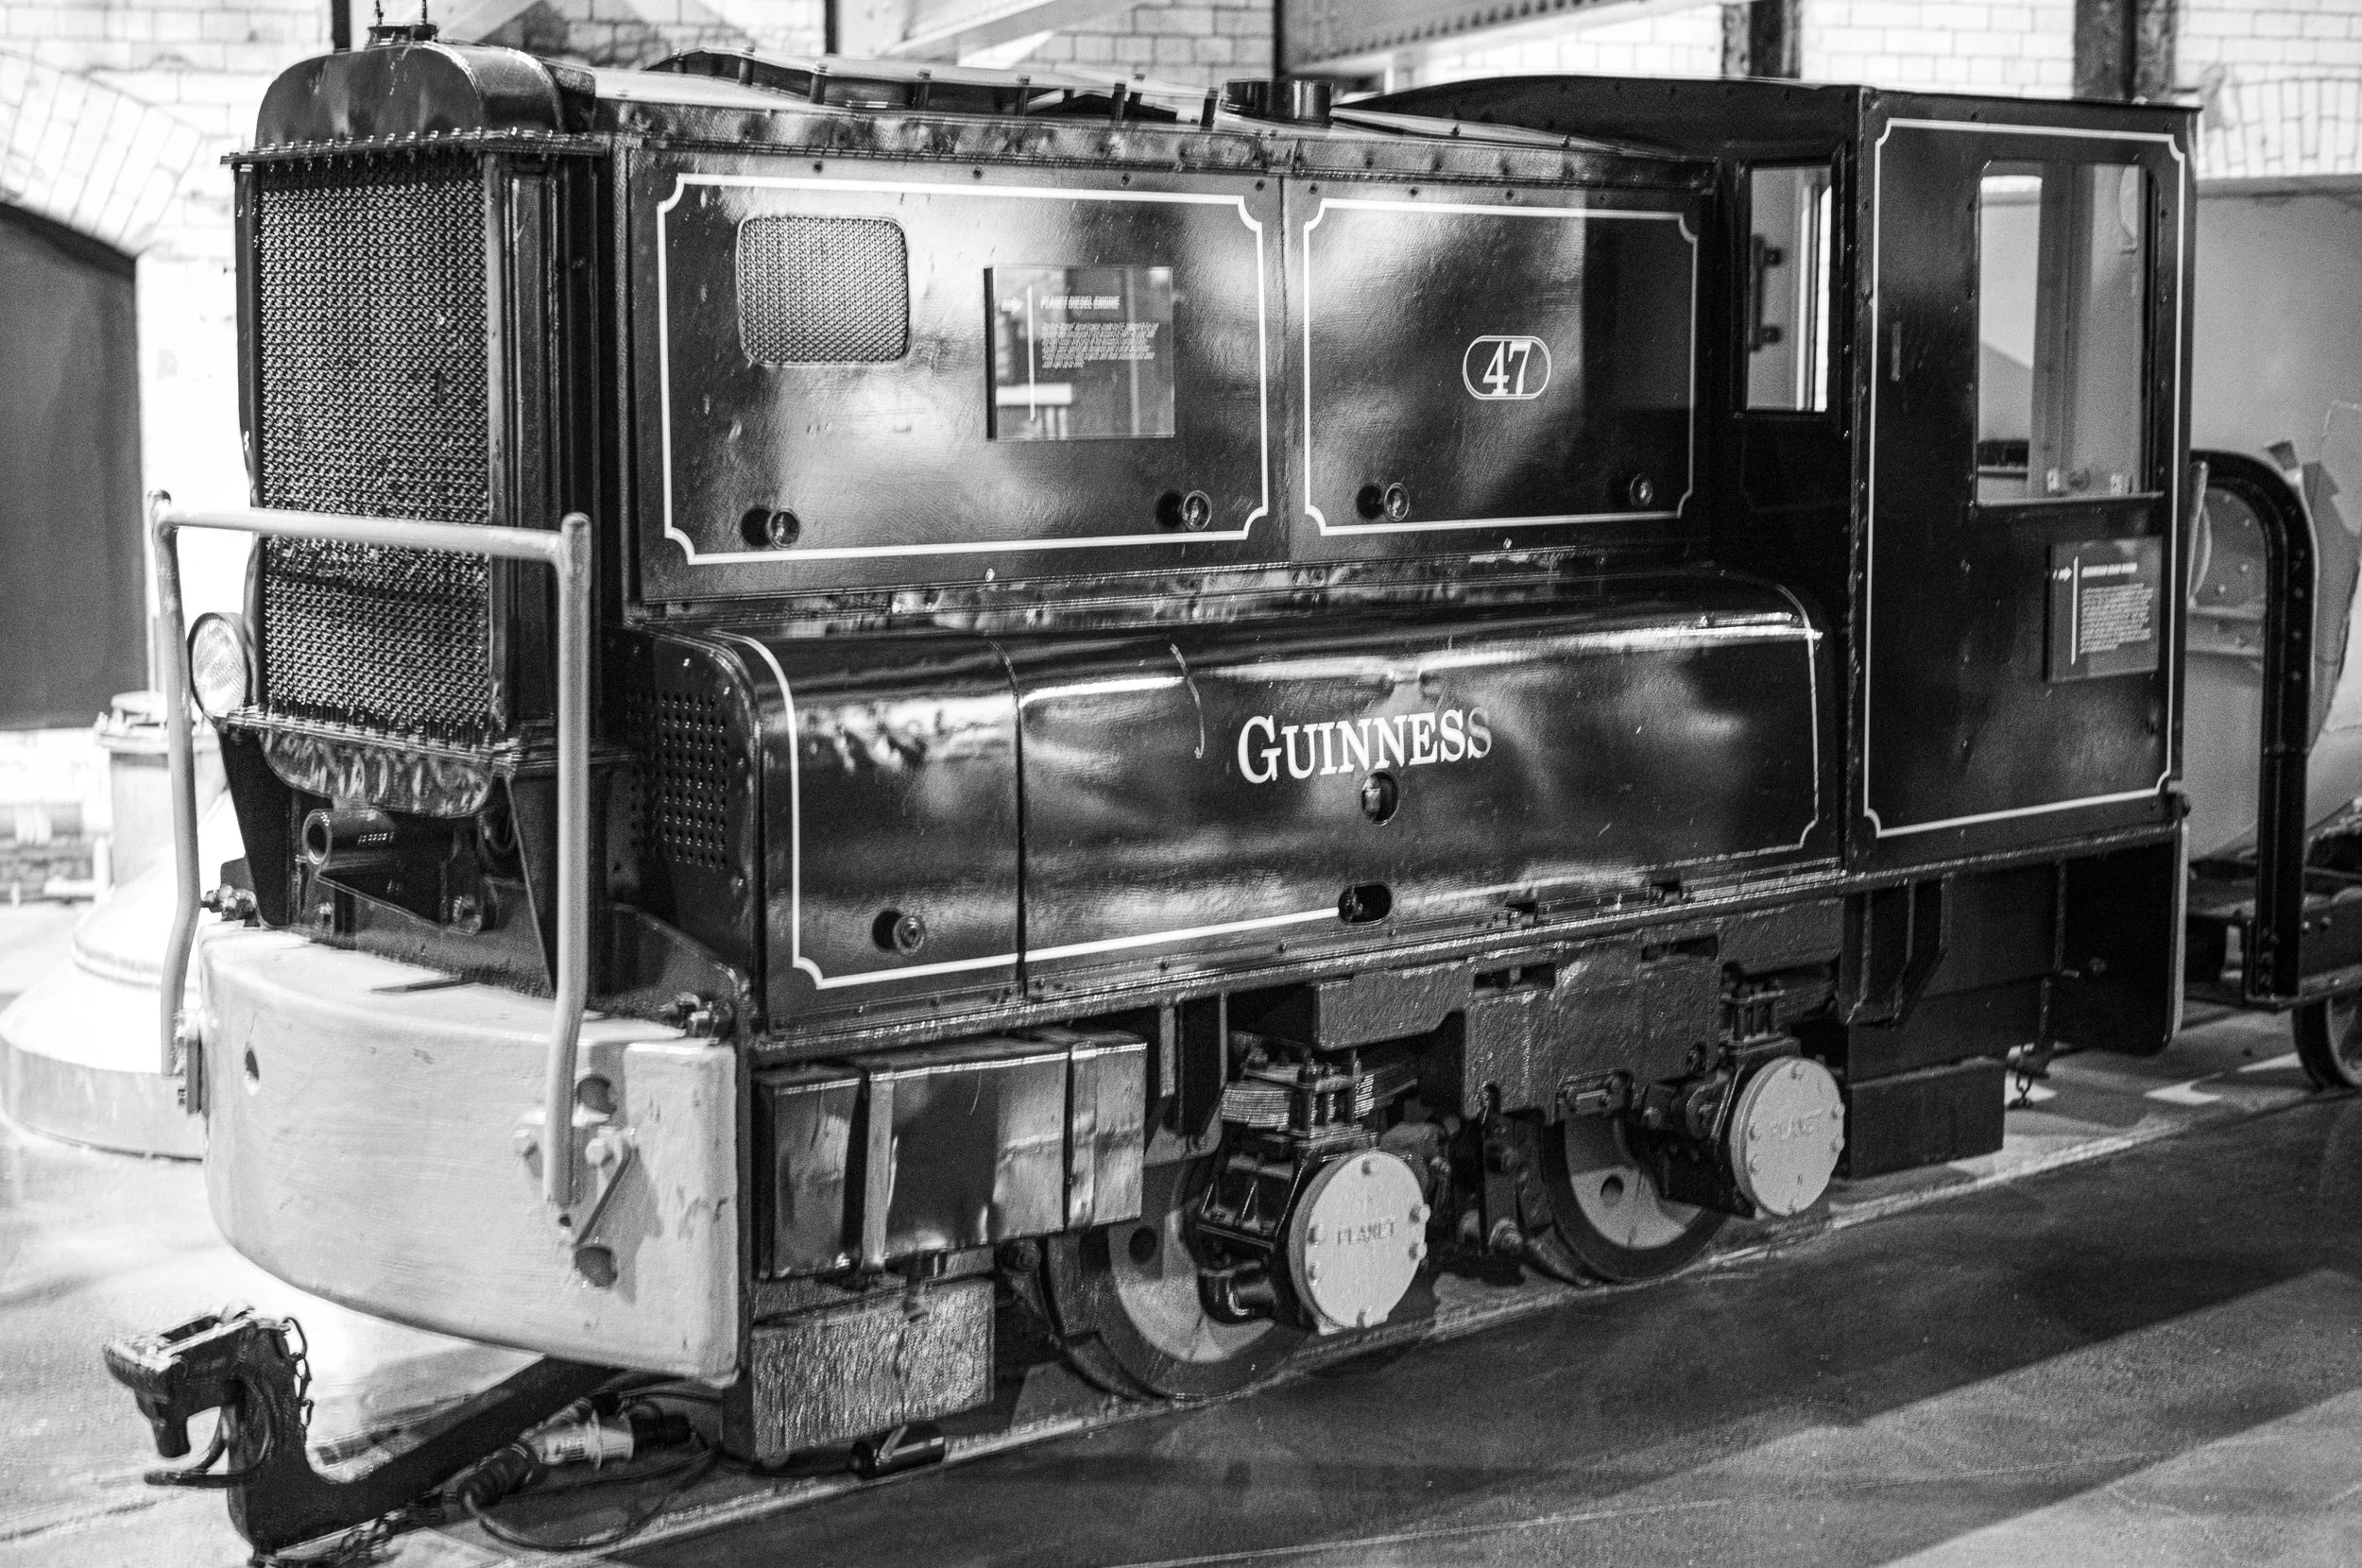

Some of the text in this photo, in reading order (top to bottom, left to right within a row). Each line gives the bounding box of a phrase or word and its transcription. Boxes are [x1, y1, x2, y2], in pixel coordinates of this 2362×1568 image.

[1069, 295, 1091, 310] DIESEL
[1093, 295, 1121, 310] ENGINE
[1482, 340, 1532, 397] 47
[1238, 707, 1492, 784] GUINNESS
